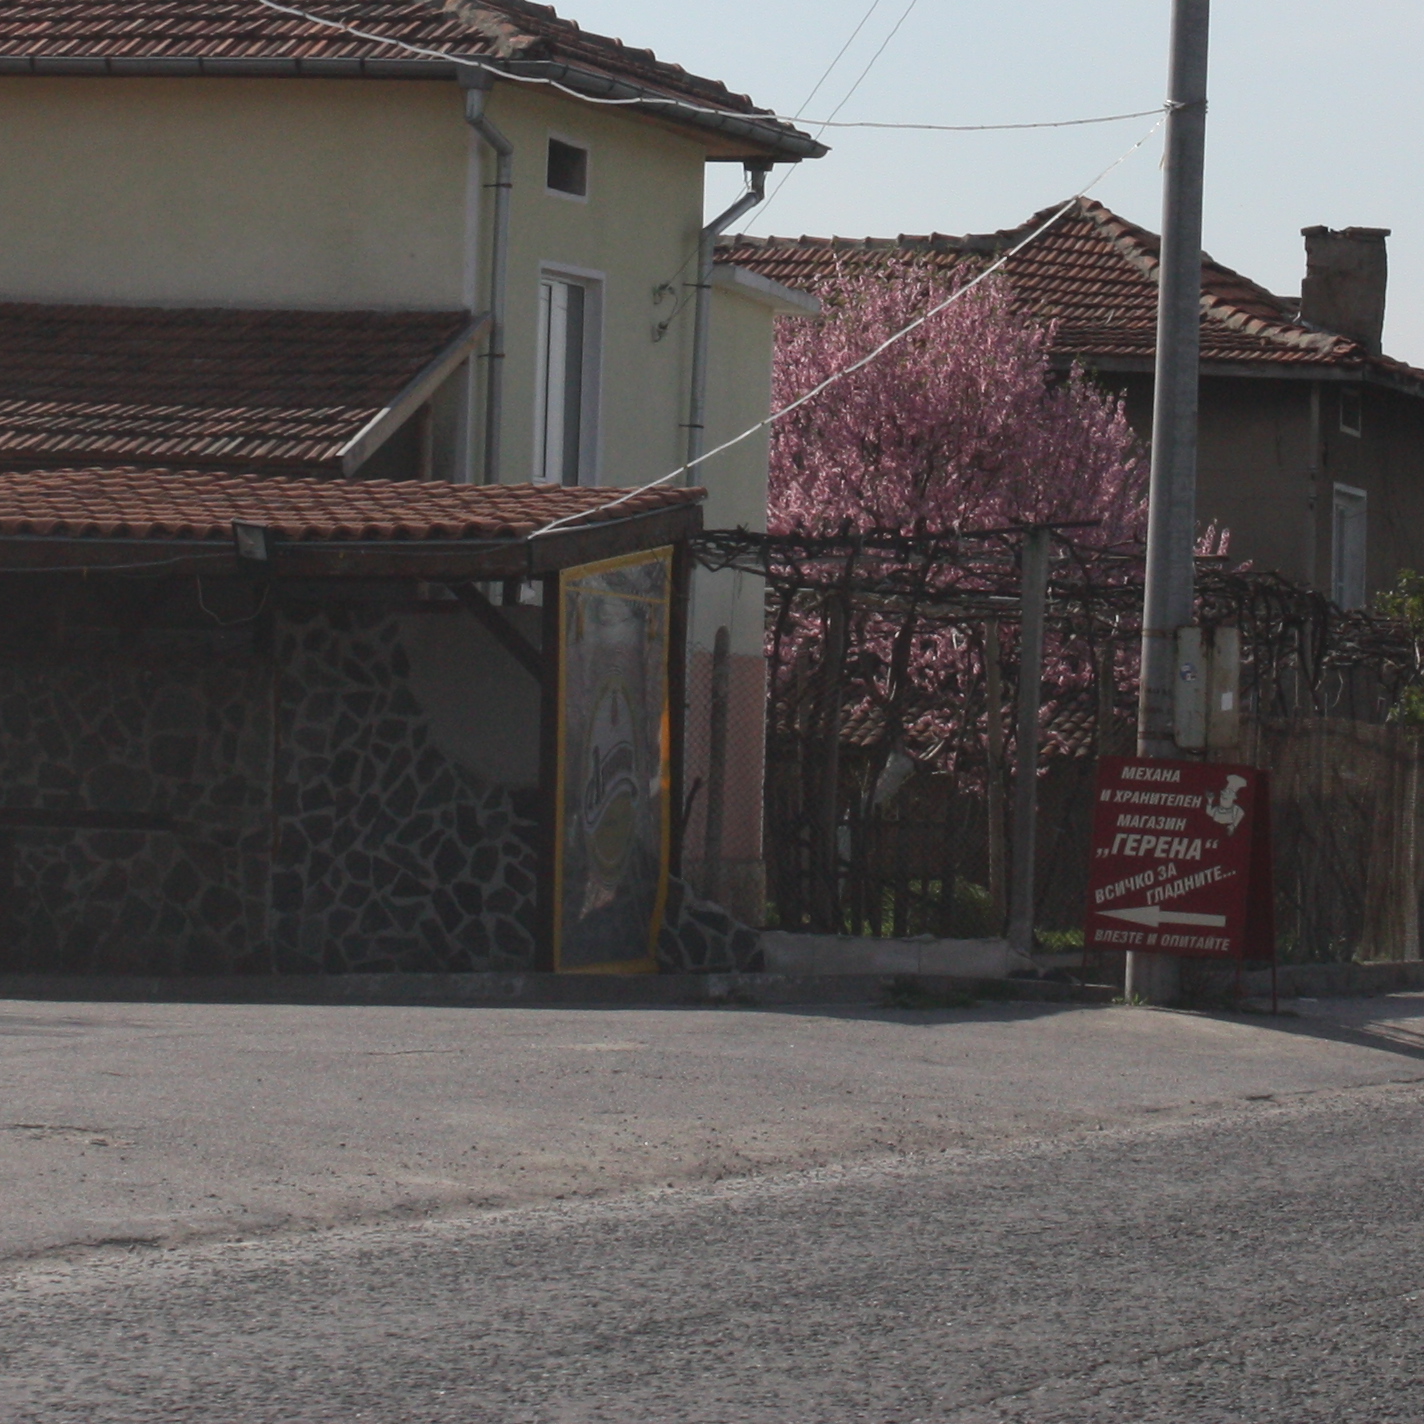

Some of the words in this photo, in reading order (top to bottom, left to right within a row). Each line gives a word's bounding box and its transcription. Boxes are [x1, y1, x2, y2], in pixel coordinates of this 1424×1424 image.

[1121, 766, 1181, 783] МЕХАНА
[1100, 789, 1112, 801] И
[1114, 790, 1202, 808] ХРАНИТЕЛЕН
[1117, 814, 1187, 831] МАГАЗИН
[1095, 870, 1154, 904] ВСИЧКО
[1157, 862, 1177, 881] ЗА
[1094, 929, 1144, 944] ВЛЕЗТЕ
[1146, 933, 1158, 945] И
[1161, 934, 1230, 950] ОПИТАЙТЕ
